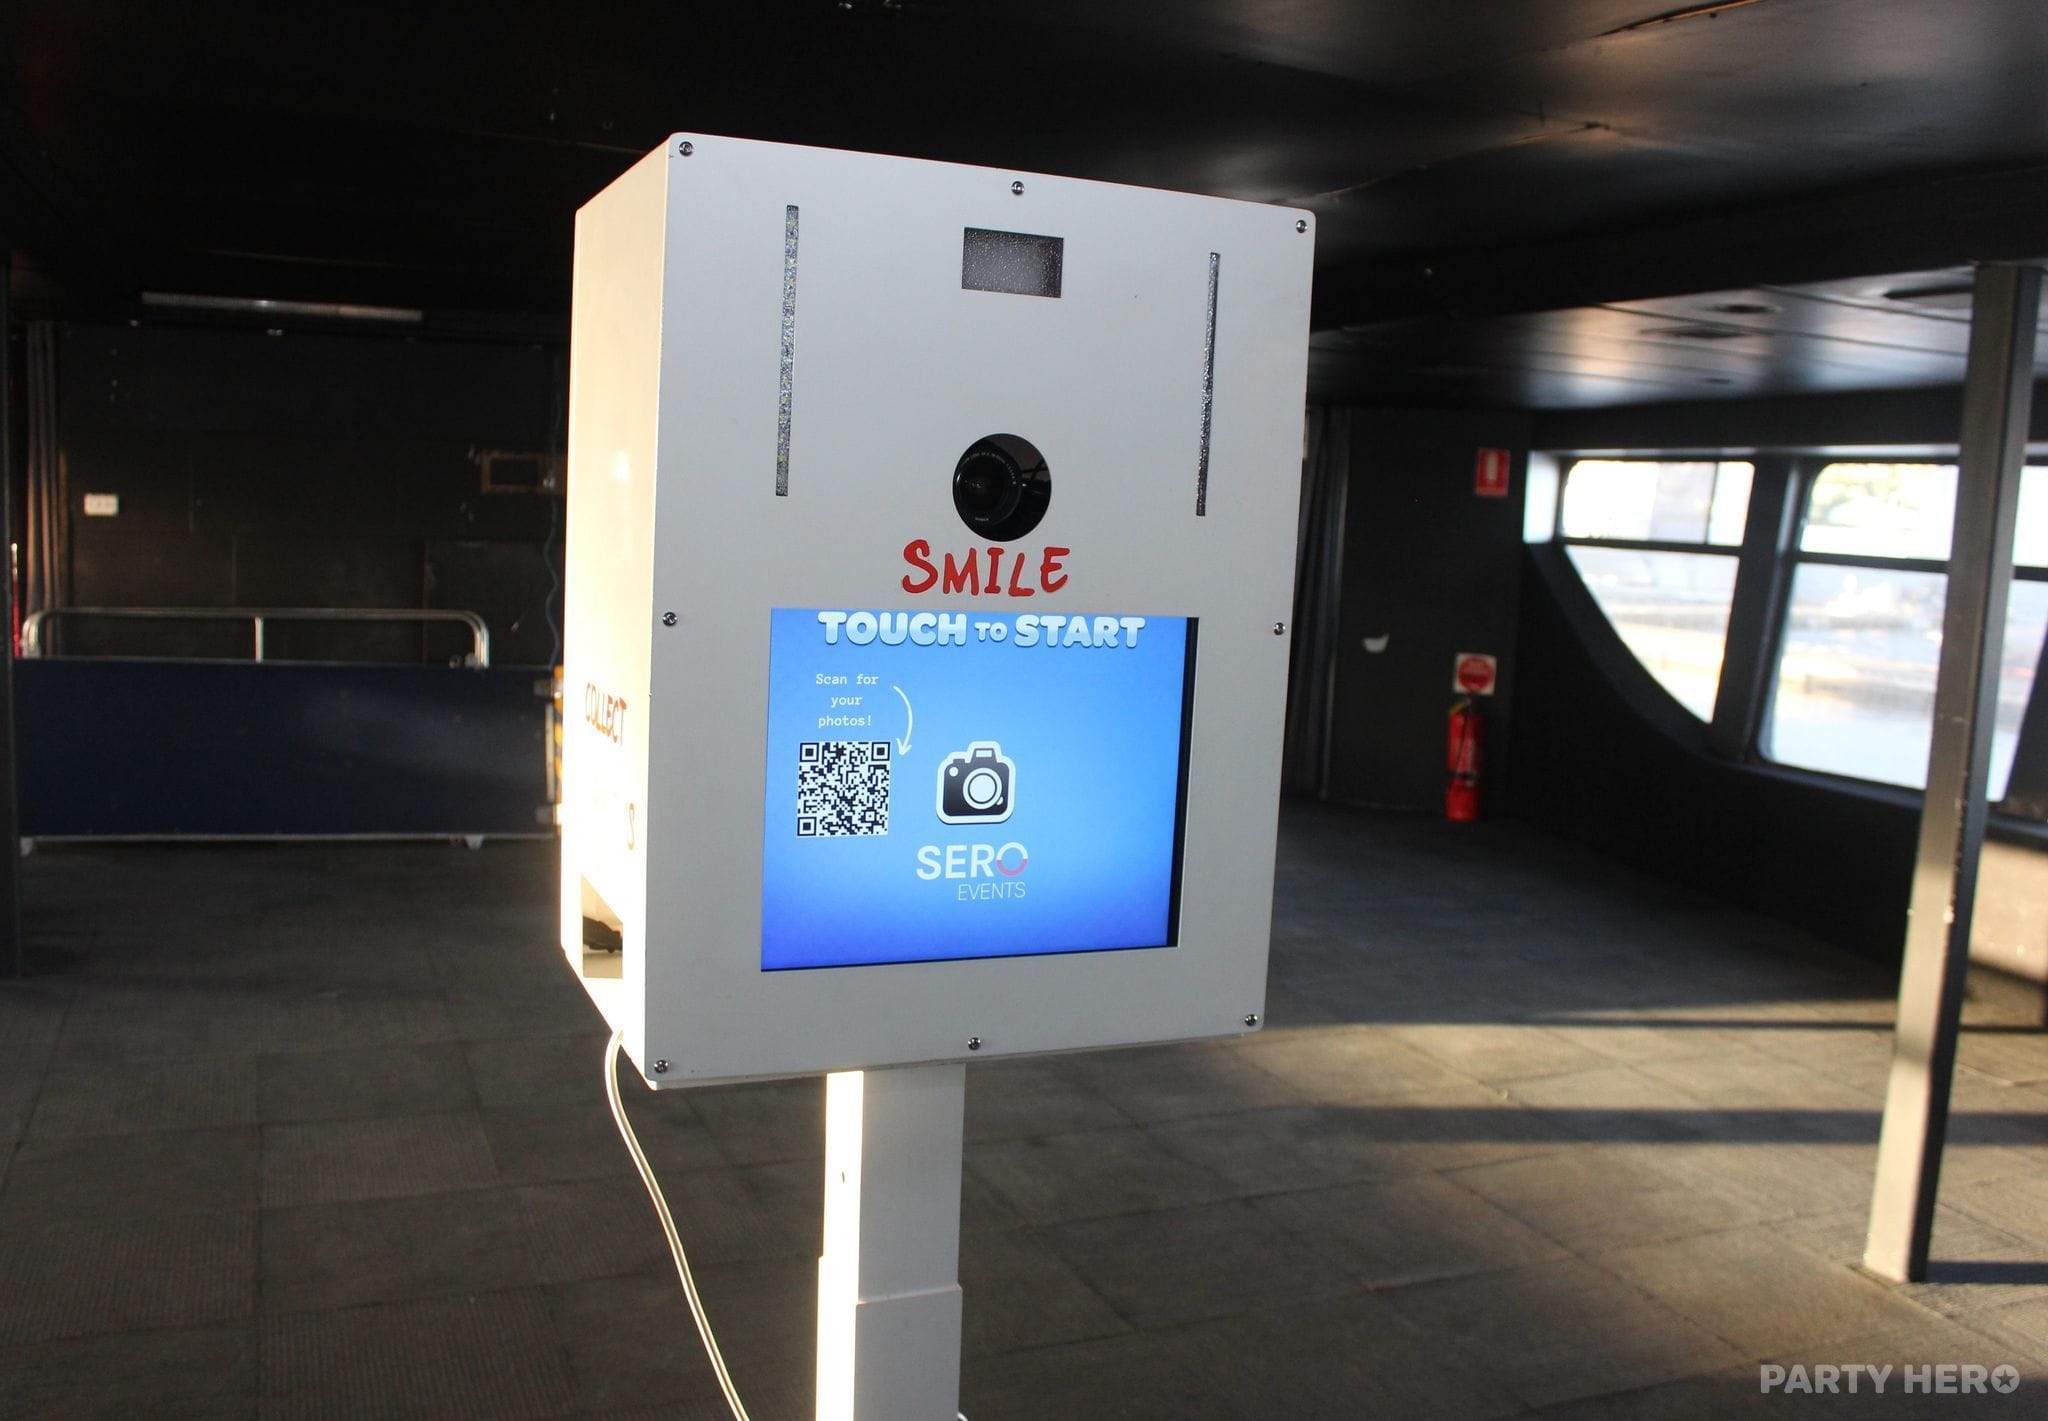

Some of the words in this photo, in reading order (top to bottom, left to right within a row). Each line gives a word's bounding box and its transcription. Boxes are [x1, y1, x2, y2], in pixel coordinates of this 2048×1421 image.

[900, 539, 1071, 597] SMILE
[817, 611, 968, 646] TOUCH
[973, 621, 1009, 642] TO
[1013, 615, 1147, 648] START
[815, 673, 848, 686] Scan
[856, 673, 880, 686] for
[585, 682, 628, 745] COLLECT
[830, 695, 863, 707] your
[818, 714, 872, 729] photos!
[915, 841, 1029, 881] SERO
[957, 882, 1026, 901] EVENTS
